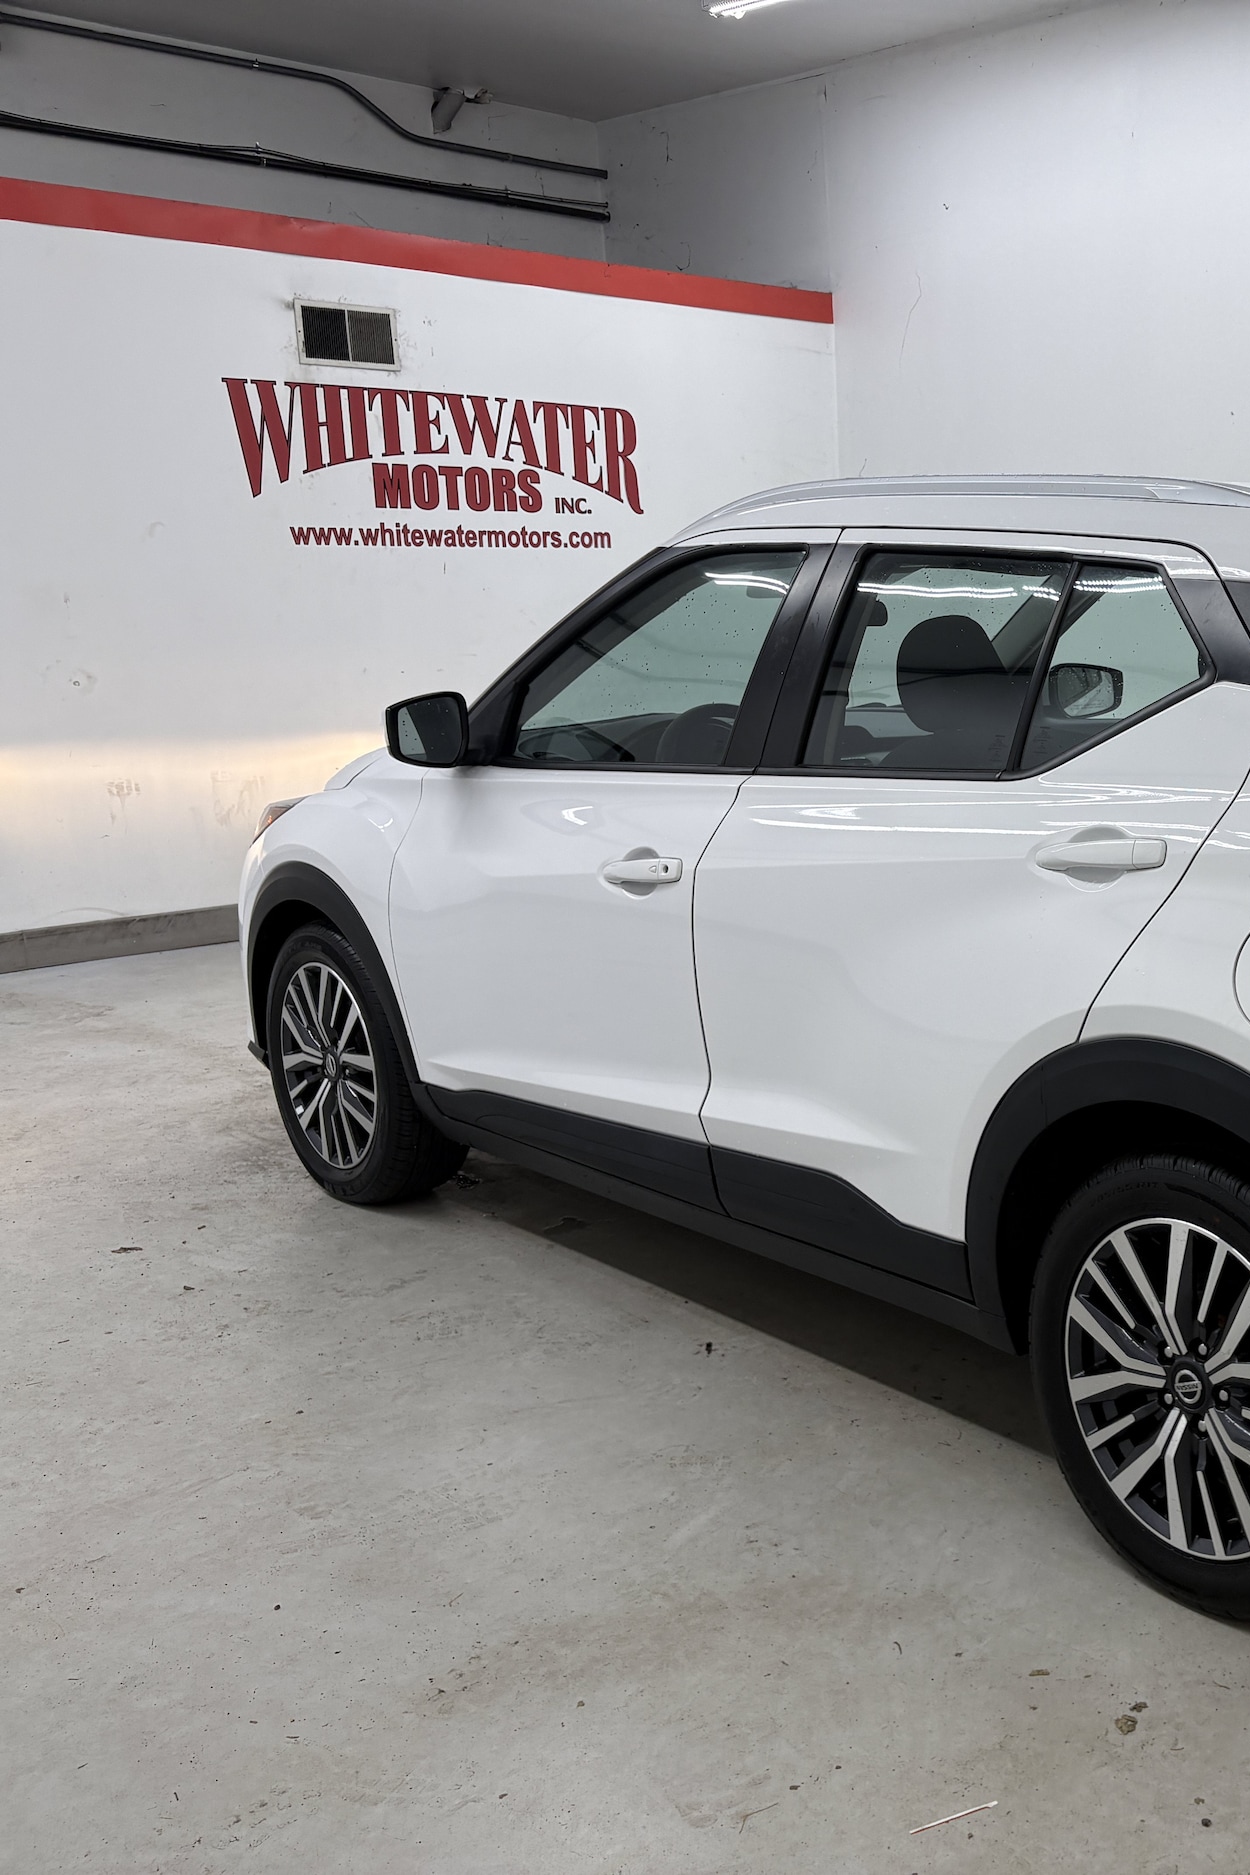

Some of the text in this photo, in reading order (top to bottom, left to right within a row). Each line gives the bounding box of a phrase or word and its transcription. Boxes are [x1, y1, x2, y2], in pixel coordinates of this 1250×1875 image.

[221, 377, 644, 515] WHITEWATER
[371, 462, 592, 515] MOTORS INC.
[290, 522, 612, 549] www.whitewatermotors.com
